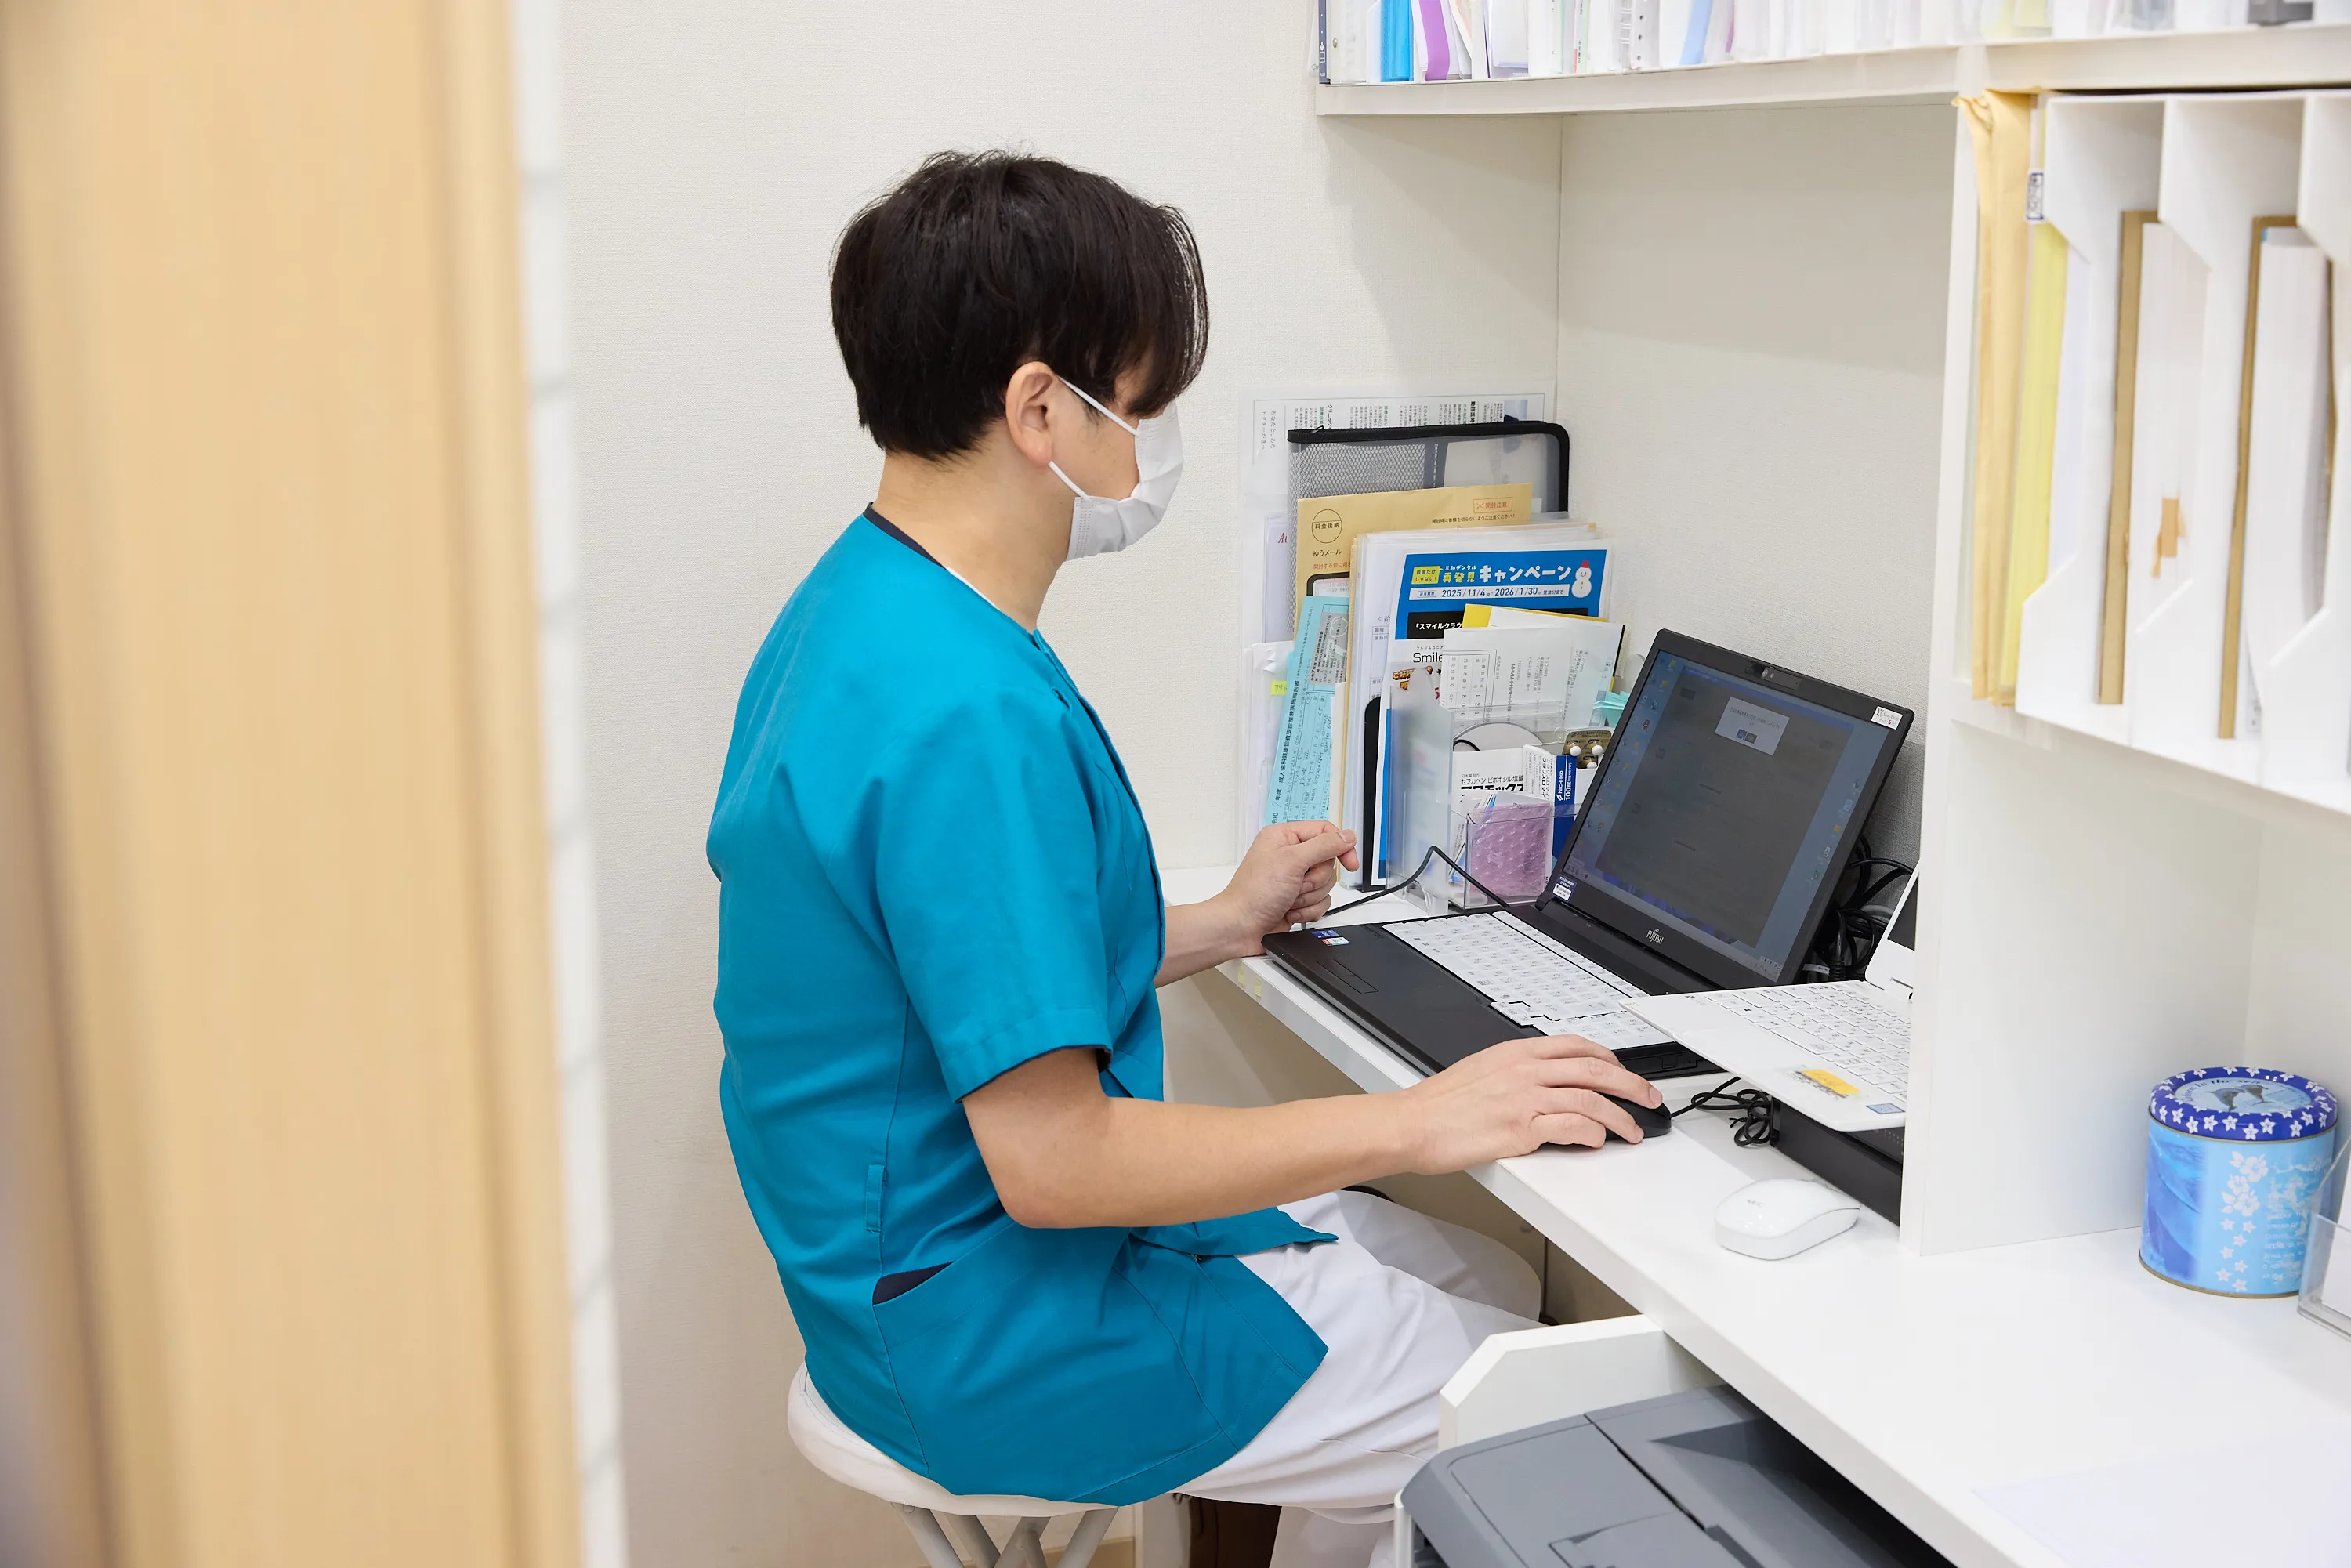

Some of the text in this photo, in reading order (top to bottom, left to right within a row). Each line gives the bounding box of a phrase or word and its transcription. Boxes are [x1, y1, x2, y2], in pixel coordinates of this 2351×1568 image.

[1443, 565, 1572, 583] 再発見 キャンペーン
[1441, 588, 1486, 598] 2025/11/4
[1494, 587, 1538, 596] 2026/1/30
[1646, 929, 1664, 945] FUJITSU
